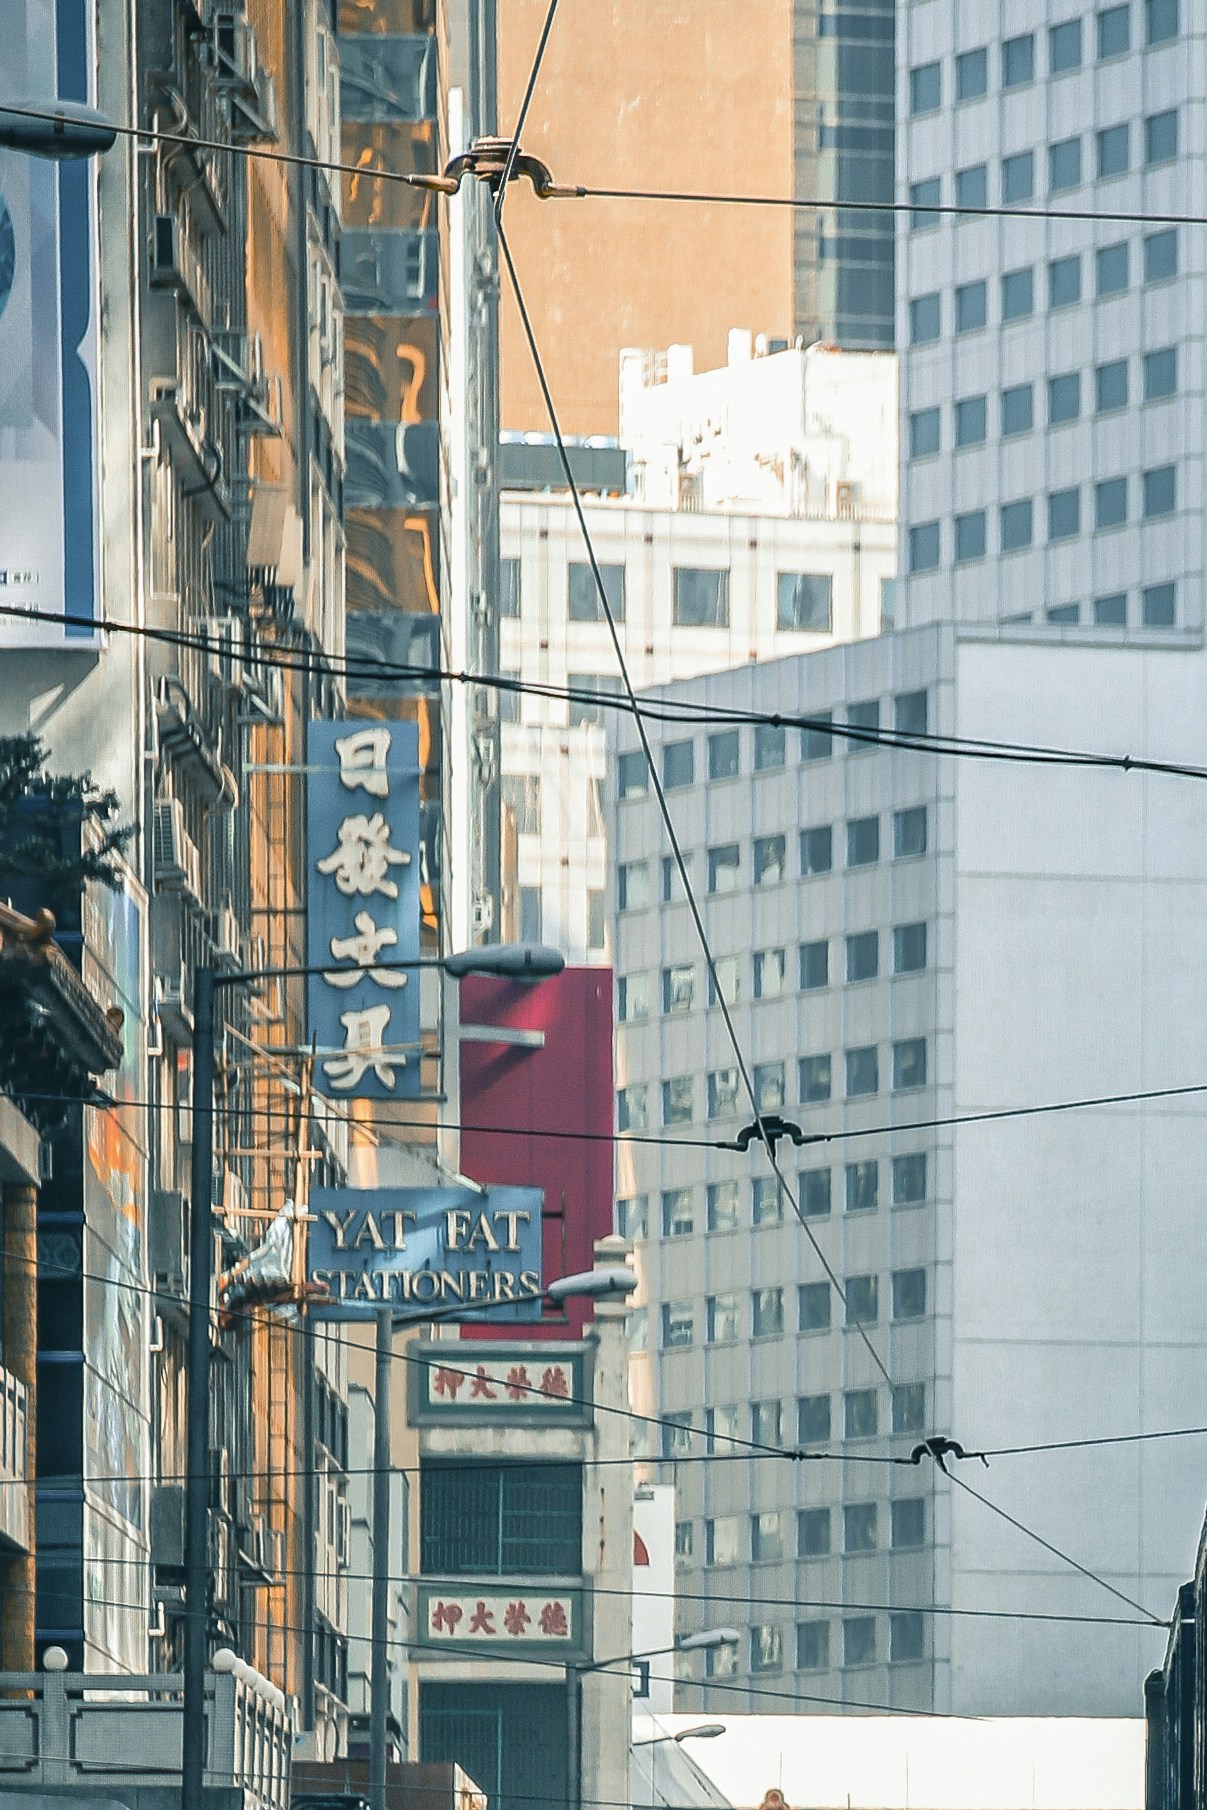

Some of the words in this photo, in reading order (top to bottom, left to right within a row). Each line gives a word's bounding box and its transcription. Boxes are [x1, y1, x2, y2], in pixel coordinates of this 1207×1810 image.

[315, 726, 412, 1090] 日發文具
[321, 1208, 417, 1251] YAT
[444, 1208, 531, 1252] FAT
[312, 1268, 541, 1302] STATIONERS
